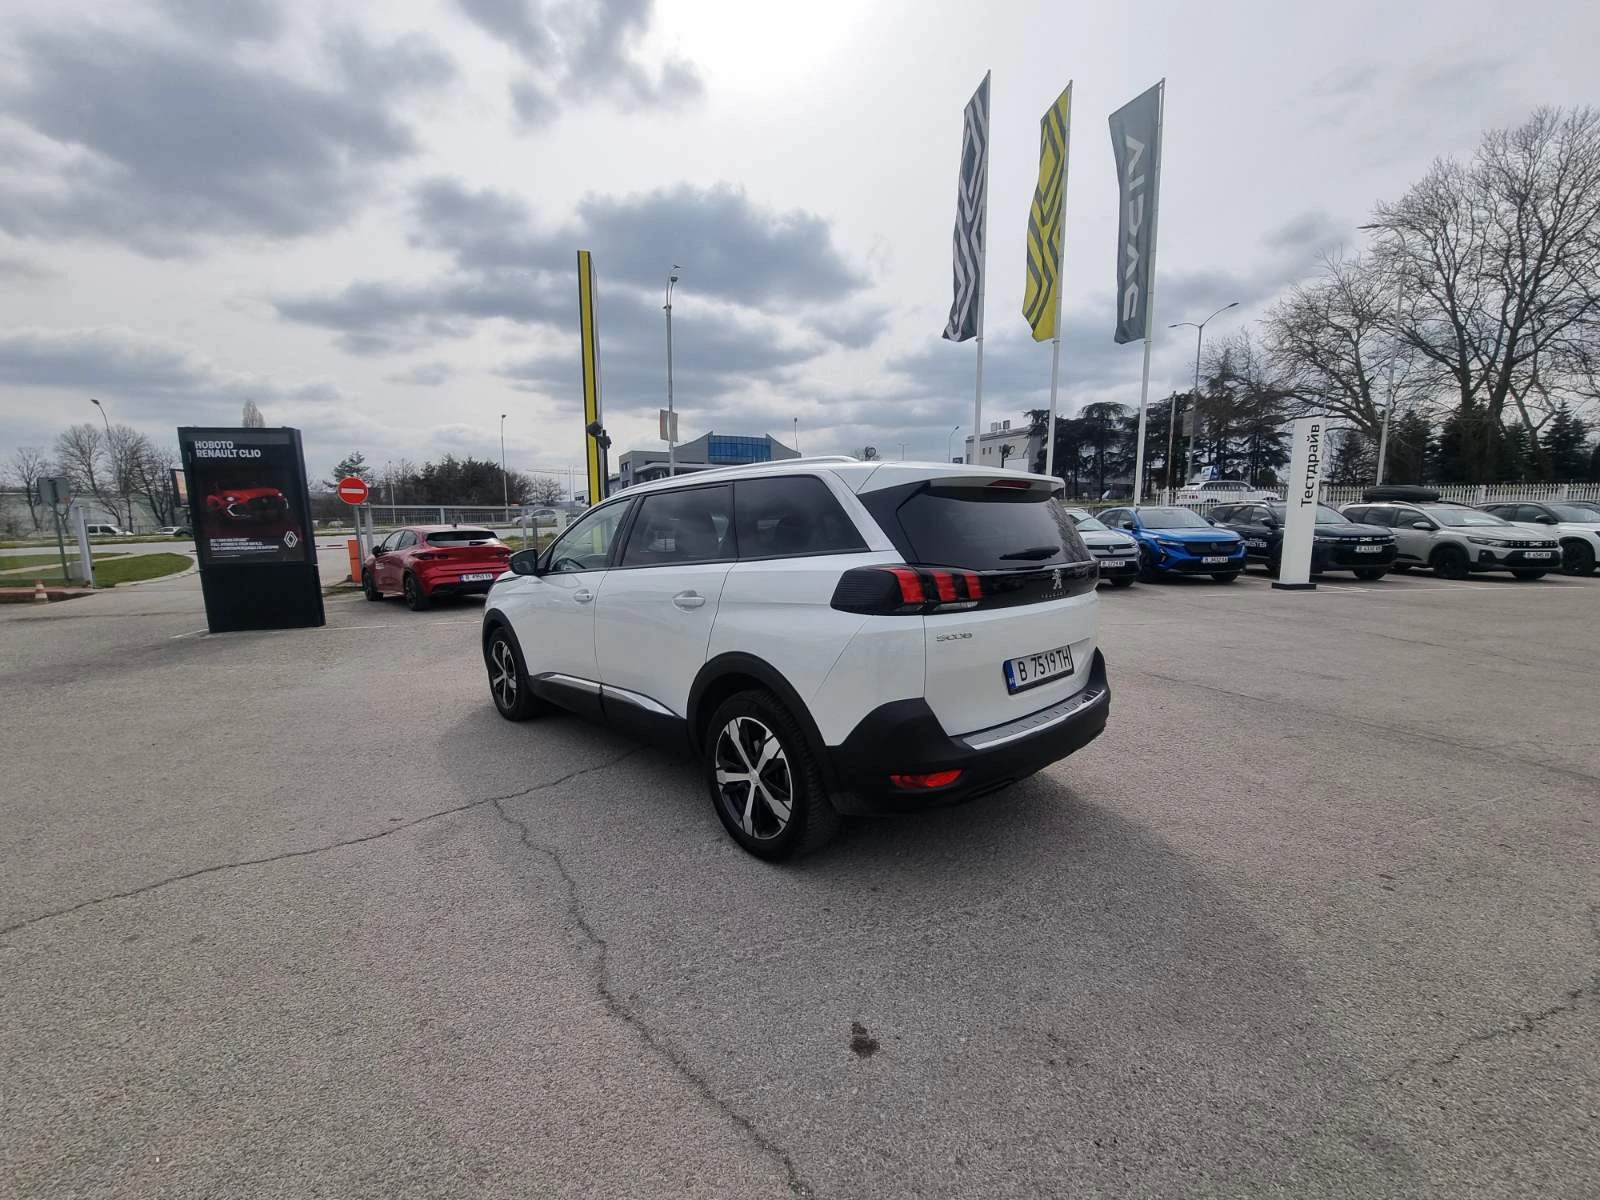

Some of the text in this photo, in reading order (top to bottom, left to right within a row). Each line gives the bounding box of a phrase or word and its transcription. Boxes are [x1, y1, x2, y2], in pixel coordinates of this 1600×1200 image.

[194, 440, 234, 449] НОВОТО
[196, 449, 262, 458] RENAULT CLIO
[1300, 424, 1320, 508] Тестдрайв
[1017, 660, 1028, 682] B
[1030, 652, 1057, 678] 7519
[1055, 647, 1071, 669] TH
